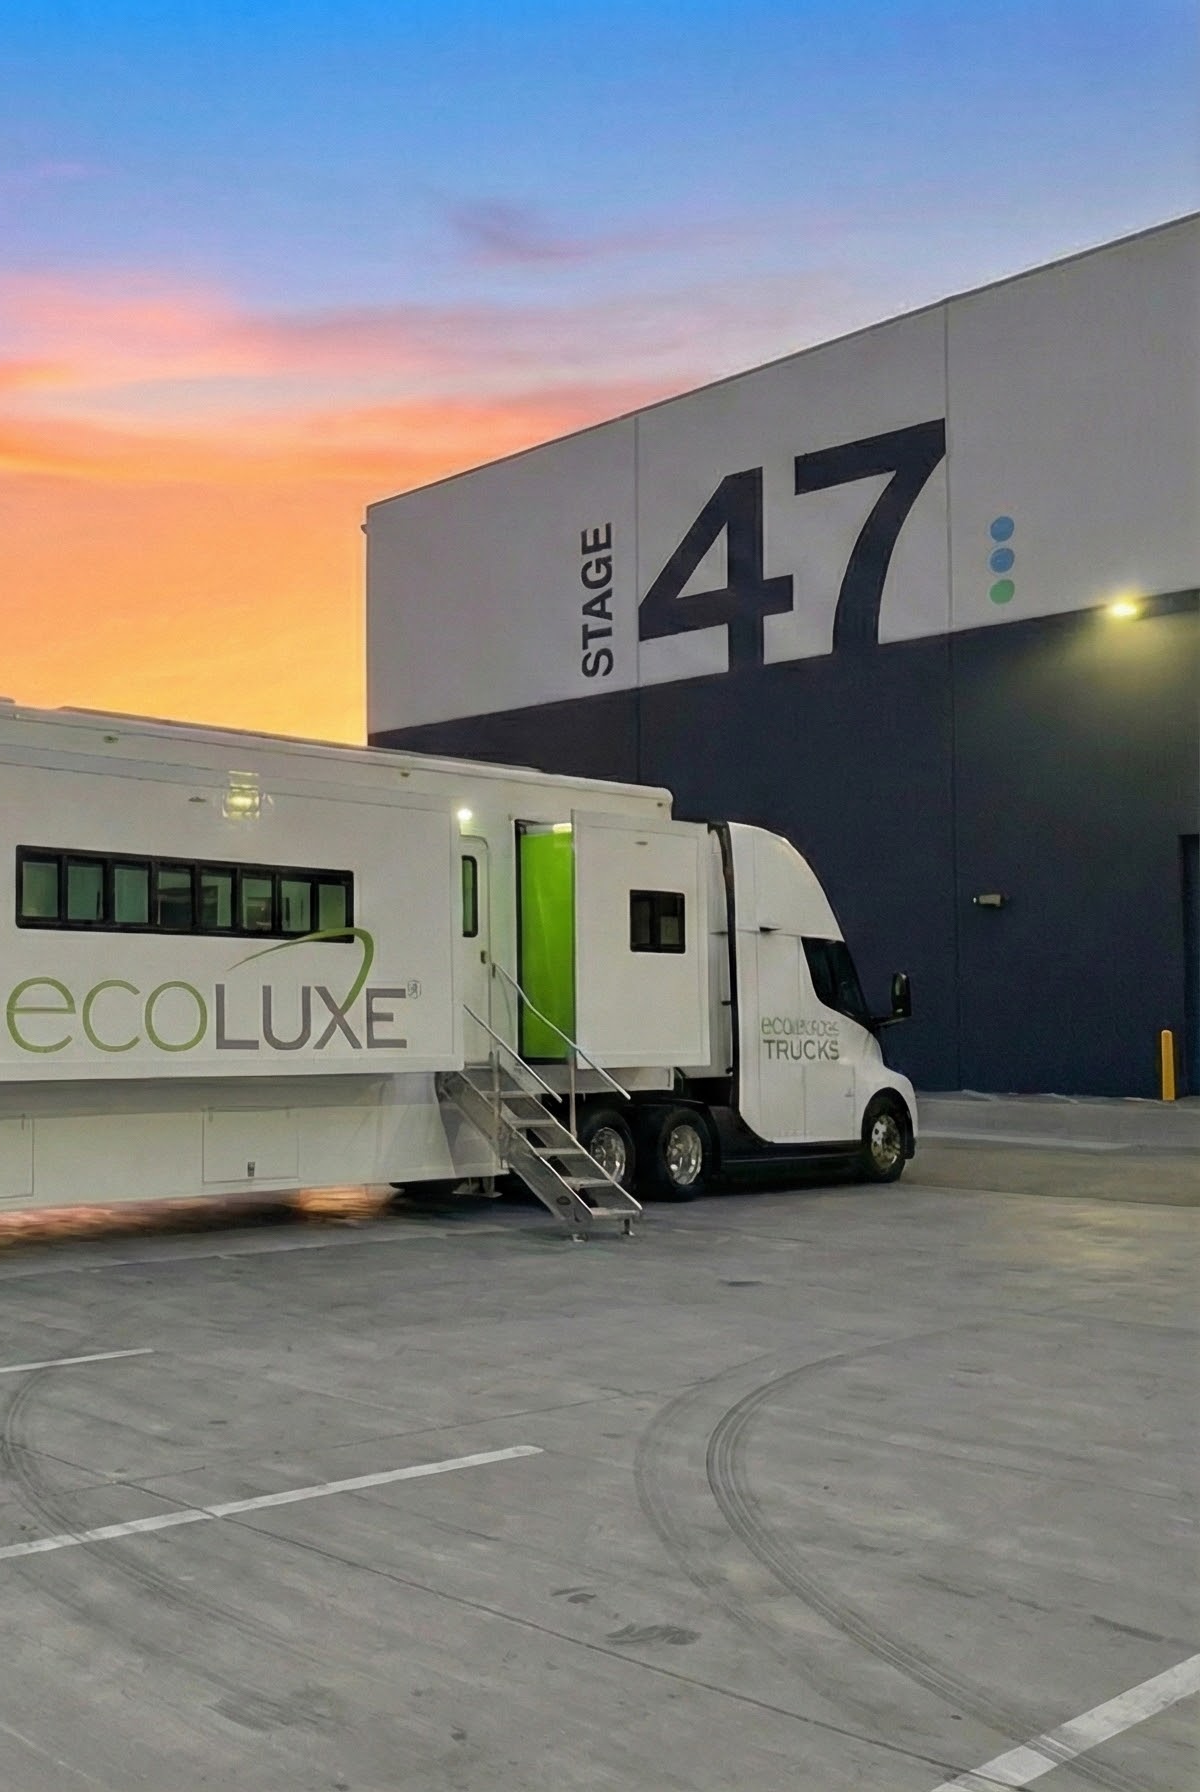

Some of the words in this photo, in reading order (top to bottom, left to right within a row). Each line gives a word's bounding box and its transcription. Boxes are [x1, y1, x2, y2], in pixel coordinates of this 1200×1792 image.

[581, 522, 614, 678] STAGE
[639, 418, 946, 673] 47
[763, 1039, 840, 1060] TRUCKS
